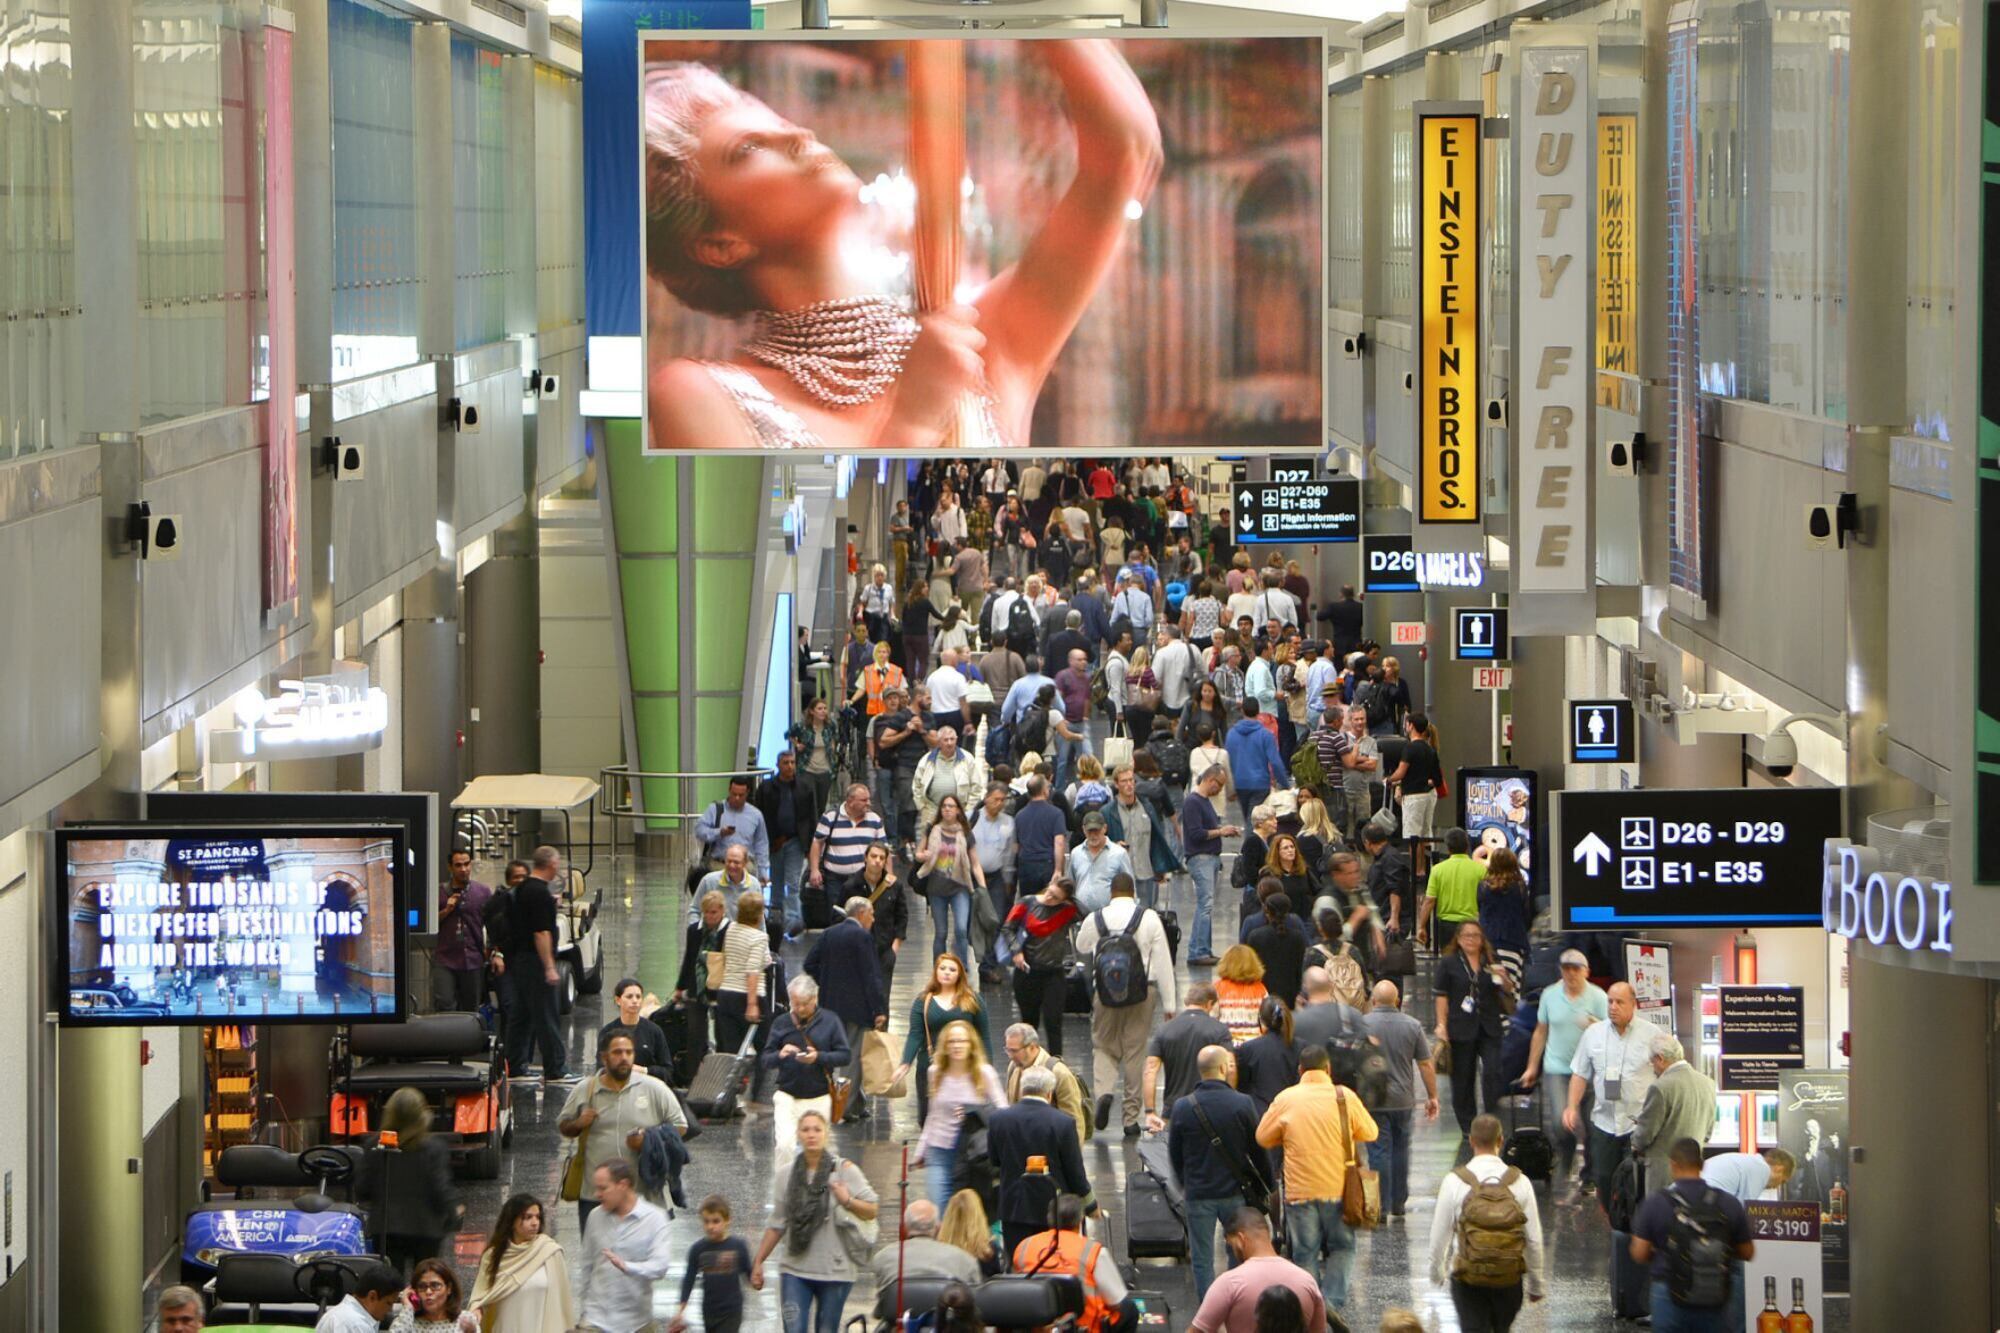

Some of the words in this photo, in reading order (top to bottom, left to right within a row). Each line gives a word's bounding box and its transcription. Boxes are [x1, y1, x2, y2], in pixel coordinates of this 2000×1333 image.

[1535, 72, 1575, 298] DUTY
[1440, 127, 1460, 376] EINSTEIN
[1439, 387, 1466, 508] BROS.
[1534, 346, 1573, 567] FREE
[1275, 470, 1309, 482] D27
[1280, 486, 1328, 497] D27-D60
[1280, 498, 1321, 510] E1-E35
[1281, 513, 1305, 524] Flight
[1307, 512, 1356, 523] Information
[1370, 551, 1415, 571] D26
[1397, 624, 1420, 642] EXIT
[1480, 669, 1504, 688] EXIT
[1662, 822, 1712, 844] D26
[1735, 821, 1785, 843] D29
[196, 846, 258, 859] PANCRAS
[1662, 862, 1692, 883] E1
[1714, 862, 1763, 883] E35
[100, 882, 181, 906] EXPLORE
[189, 880, 298, 906] THOUSANDS
[305, 881, 328, 905] OF
[100, 912, 219, 937] UNEXPECTED
[227, 911, 363, 935] DESTINATIONS
[101, 943, 176, 967] AROUND
[184, 943, 219, 966] THE
[1725, 995, 1763, 1003] Experience
[1764, 994, 1776, 1002] the
[253, 1210, 286, 1219] CSM
[1747, 1206, 1768, 1216] MIX
[1782, 1207, 1816, 1217] MATCH
[1759, 1219, 1767, 1234] 2
[216, 1232, 275, 1242] AMERICA
